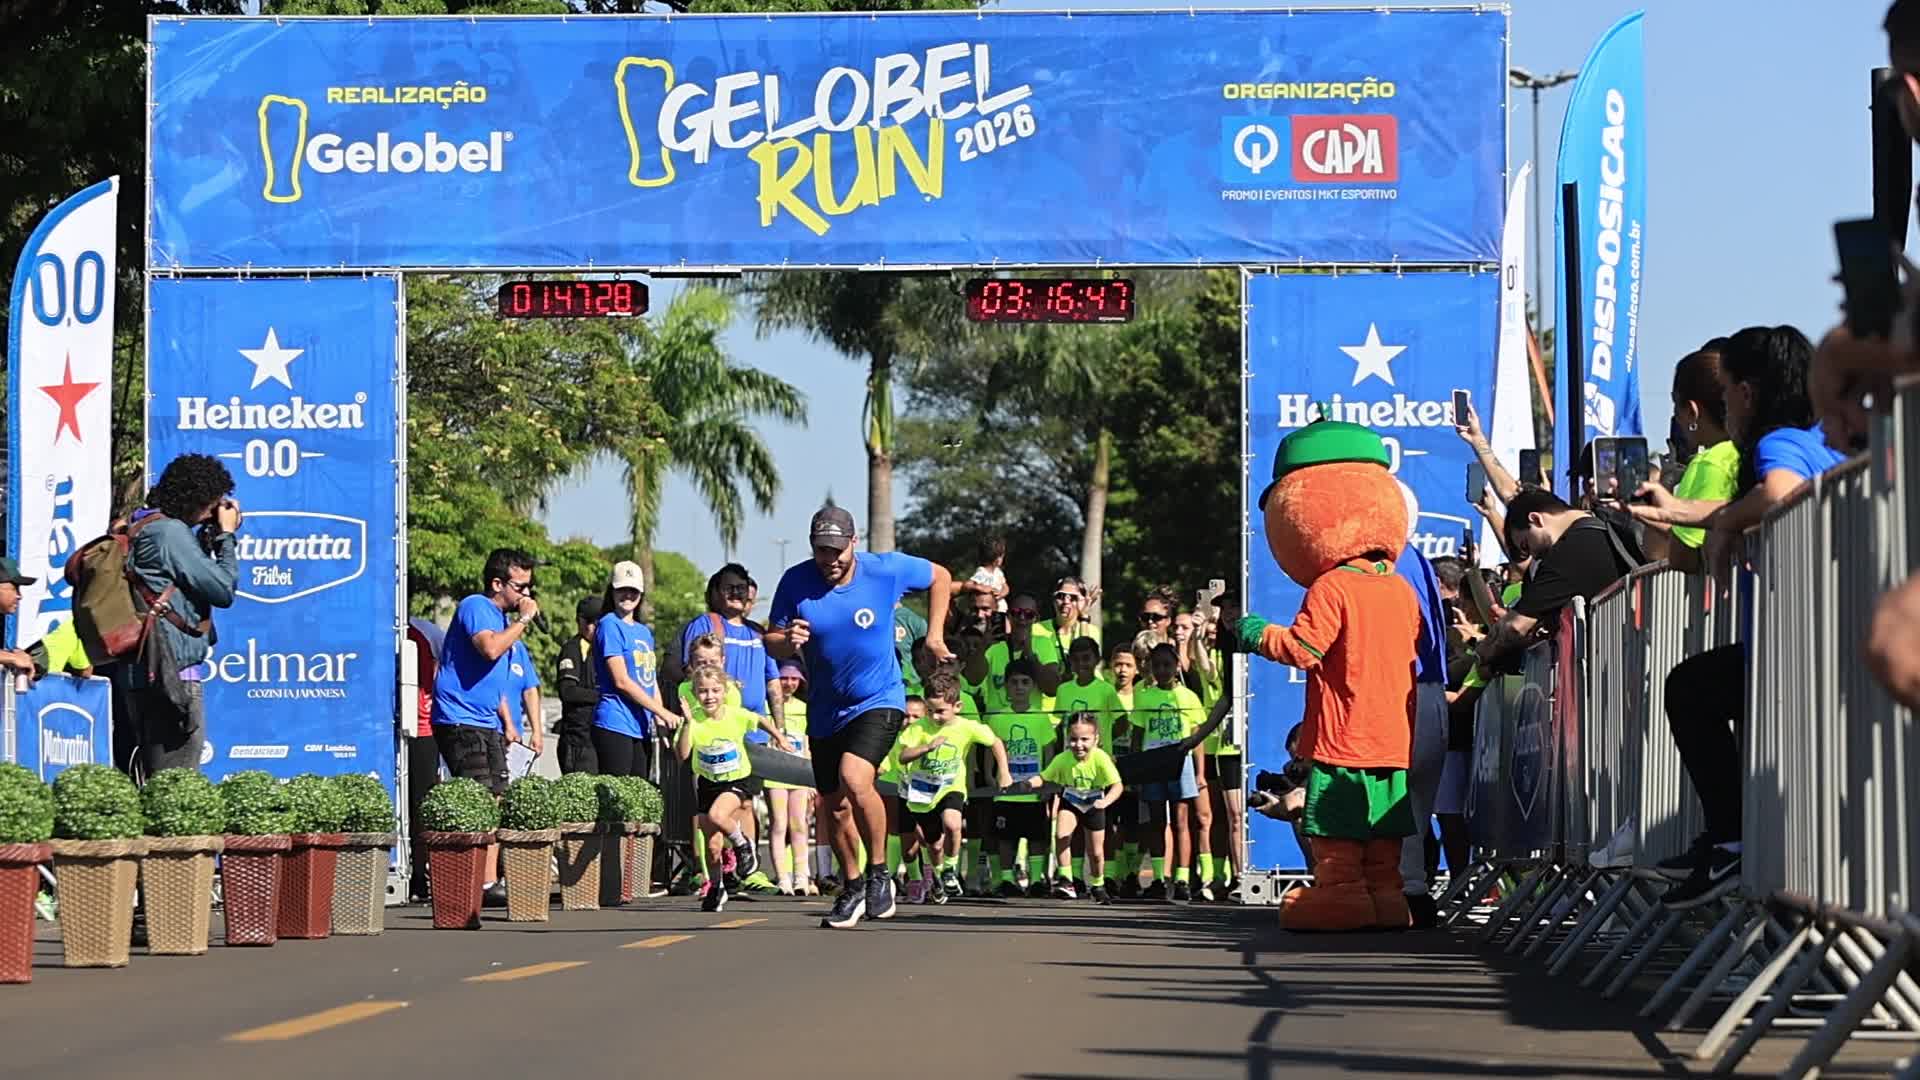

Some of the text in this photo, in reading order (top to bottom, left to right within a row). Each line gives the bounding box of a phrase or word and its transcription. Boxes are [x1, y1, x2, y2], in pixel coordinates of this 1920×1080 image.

[327, 81, 487, 109] REALIZAÇÃO
[658, 42, 1032, 163] GELOBEL
[1223, 76, 1396, 104] ORGANIZAÇÃO
[954, 103, 1036, 162] 2026
[1302, 123, 1384, 174] CAPA
[747, 117, 944, 236] RUN
[1341, 189, 1398, 200] ESPORTIVO
[981, 282, 1128, 314] 03:16:47
[245, 439, 298, 477] 0.0
[236, 534, 352, 560] turatta
